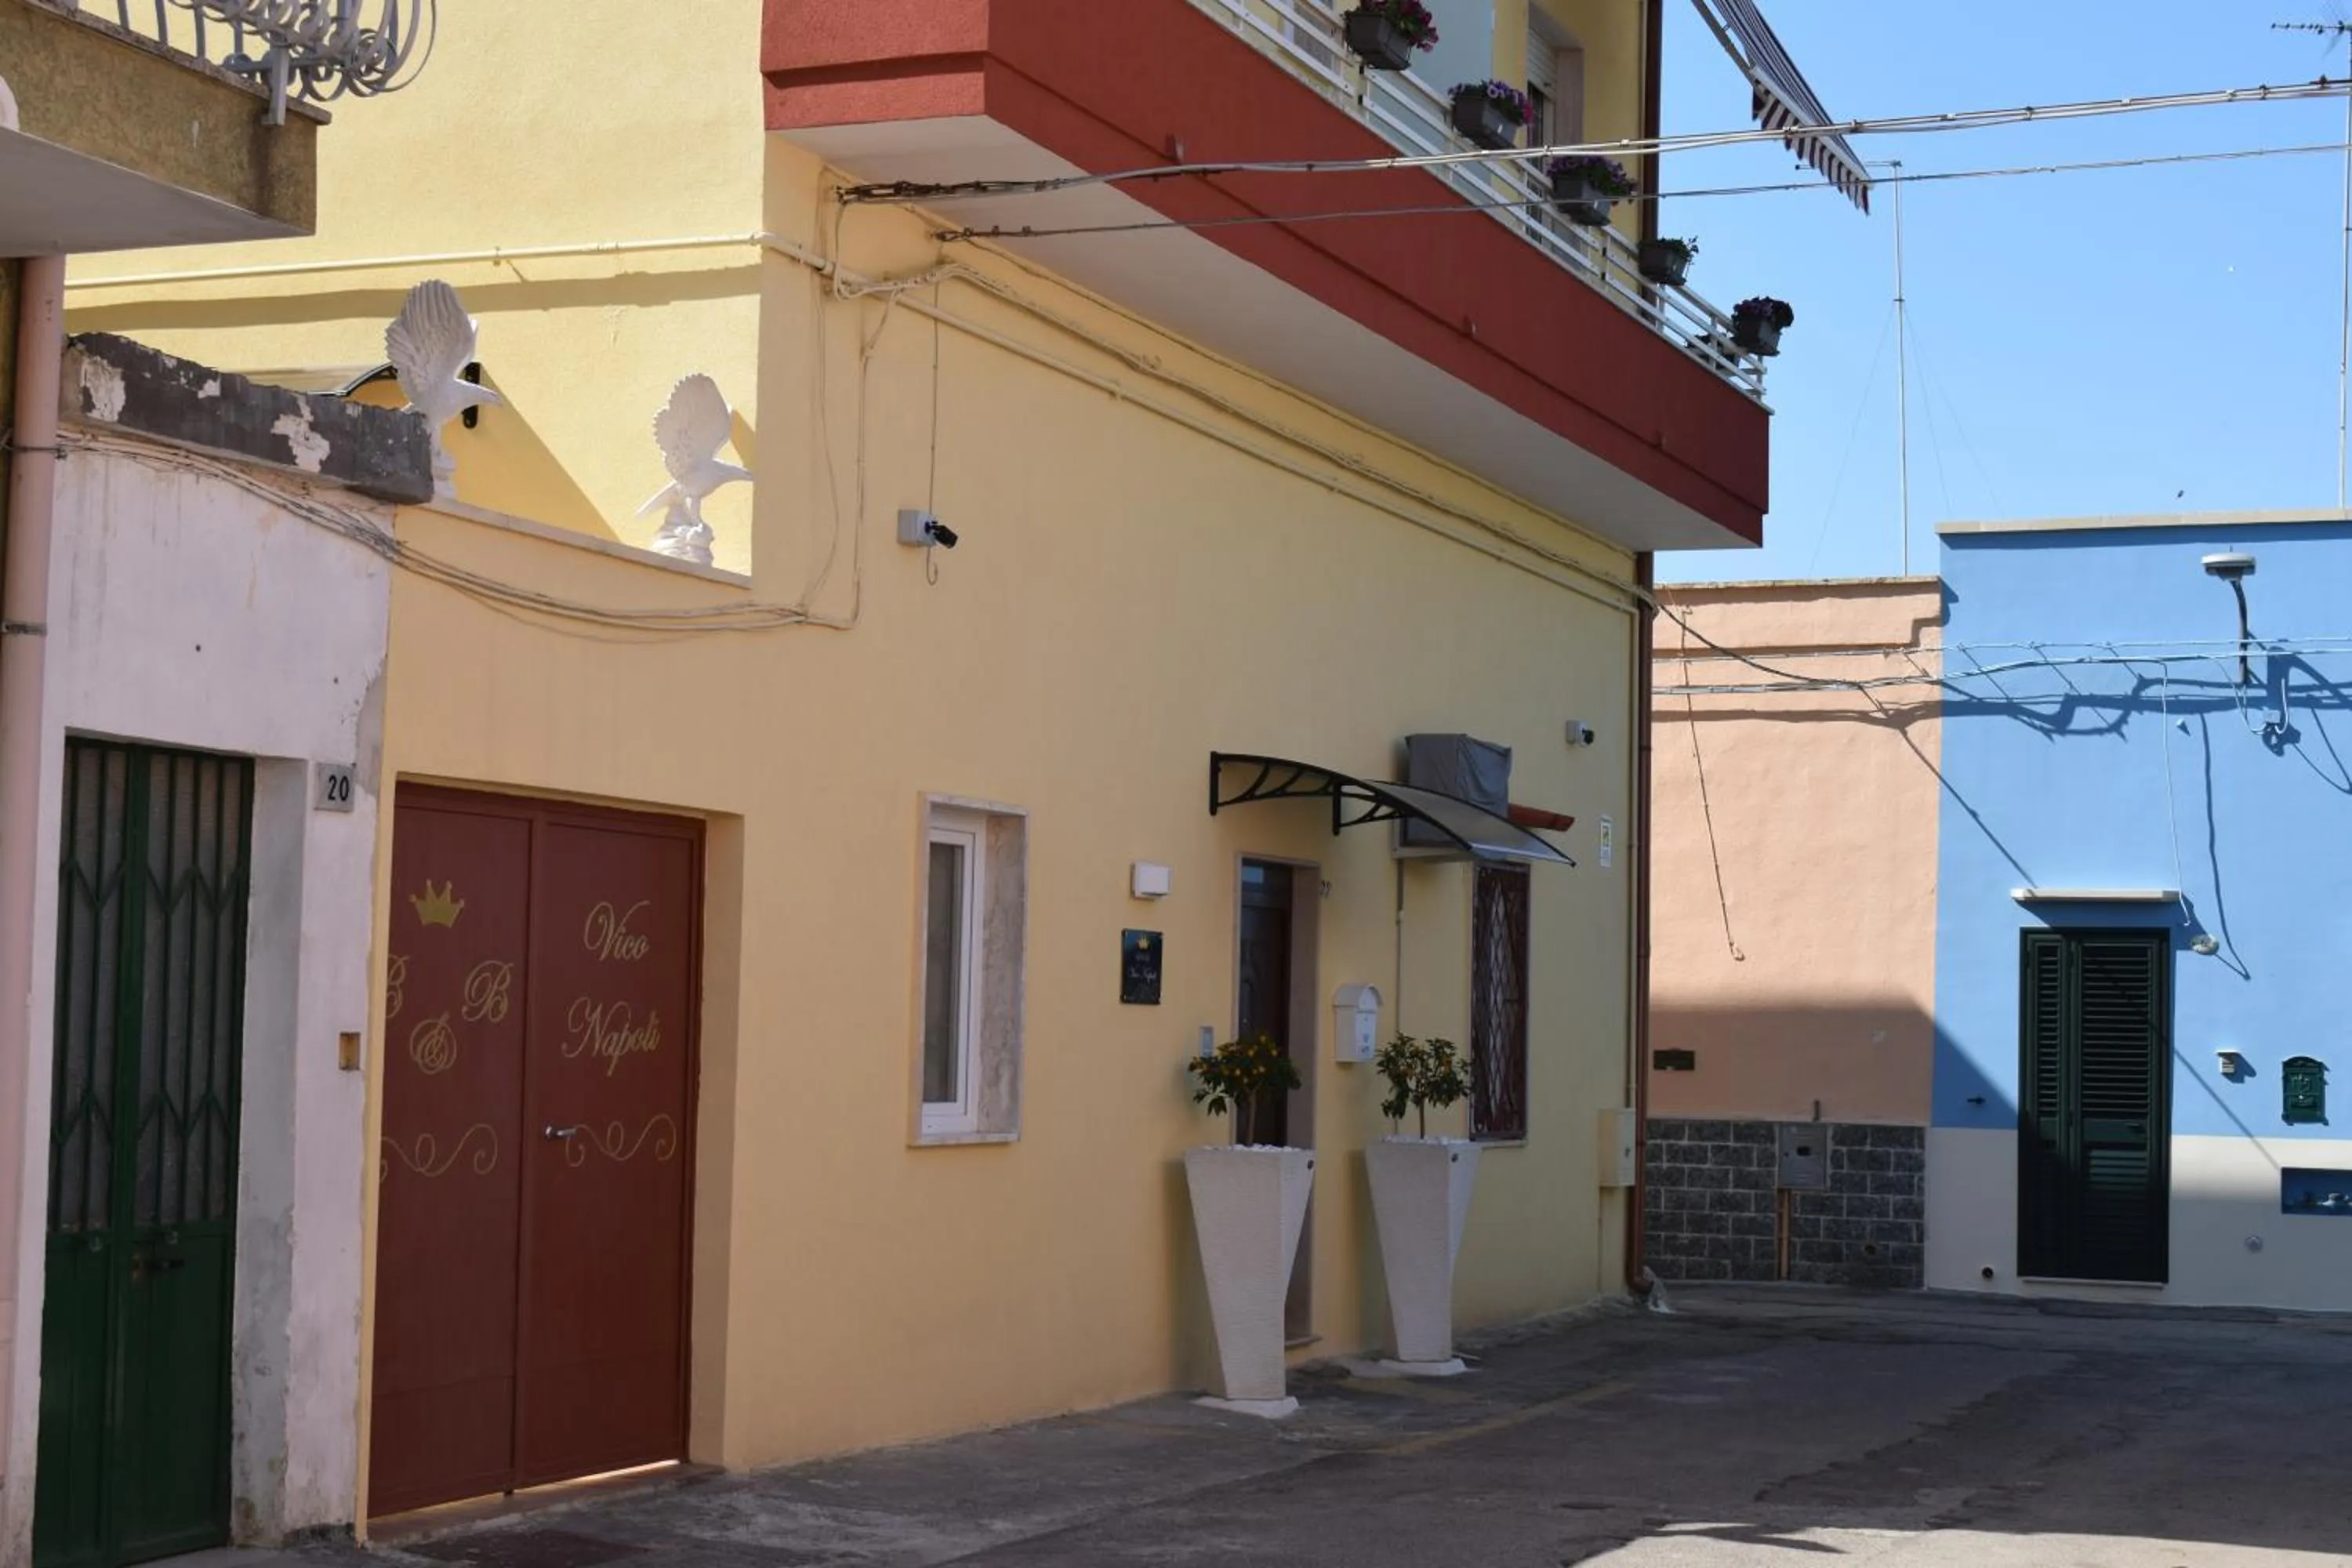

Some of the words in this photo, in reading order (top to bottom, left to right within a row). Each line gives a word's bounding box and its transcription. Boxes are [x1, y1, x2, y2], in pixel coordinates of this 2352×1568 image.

[328, 775, 349, 801] 20
[584, 901, 650, 961] Vico
[461, 960, 514, 1022] B
[561, 997, 660, 1076] Napoli
